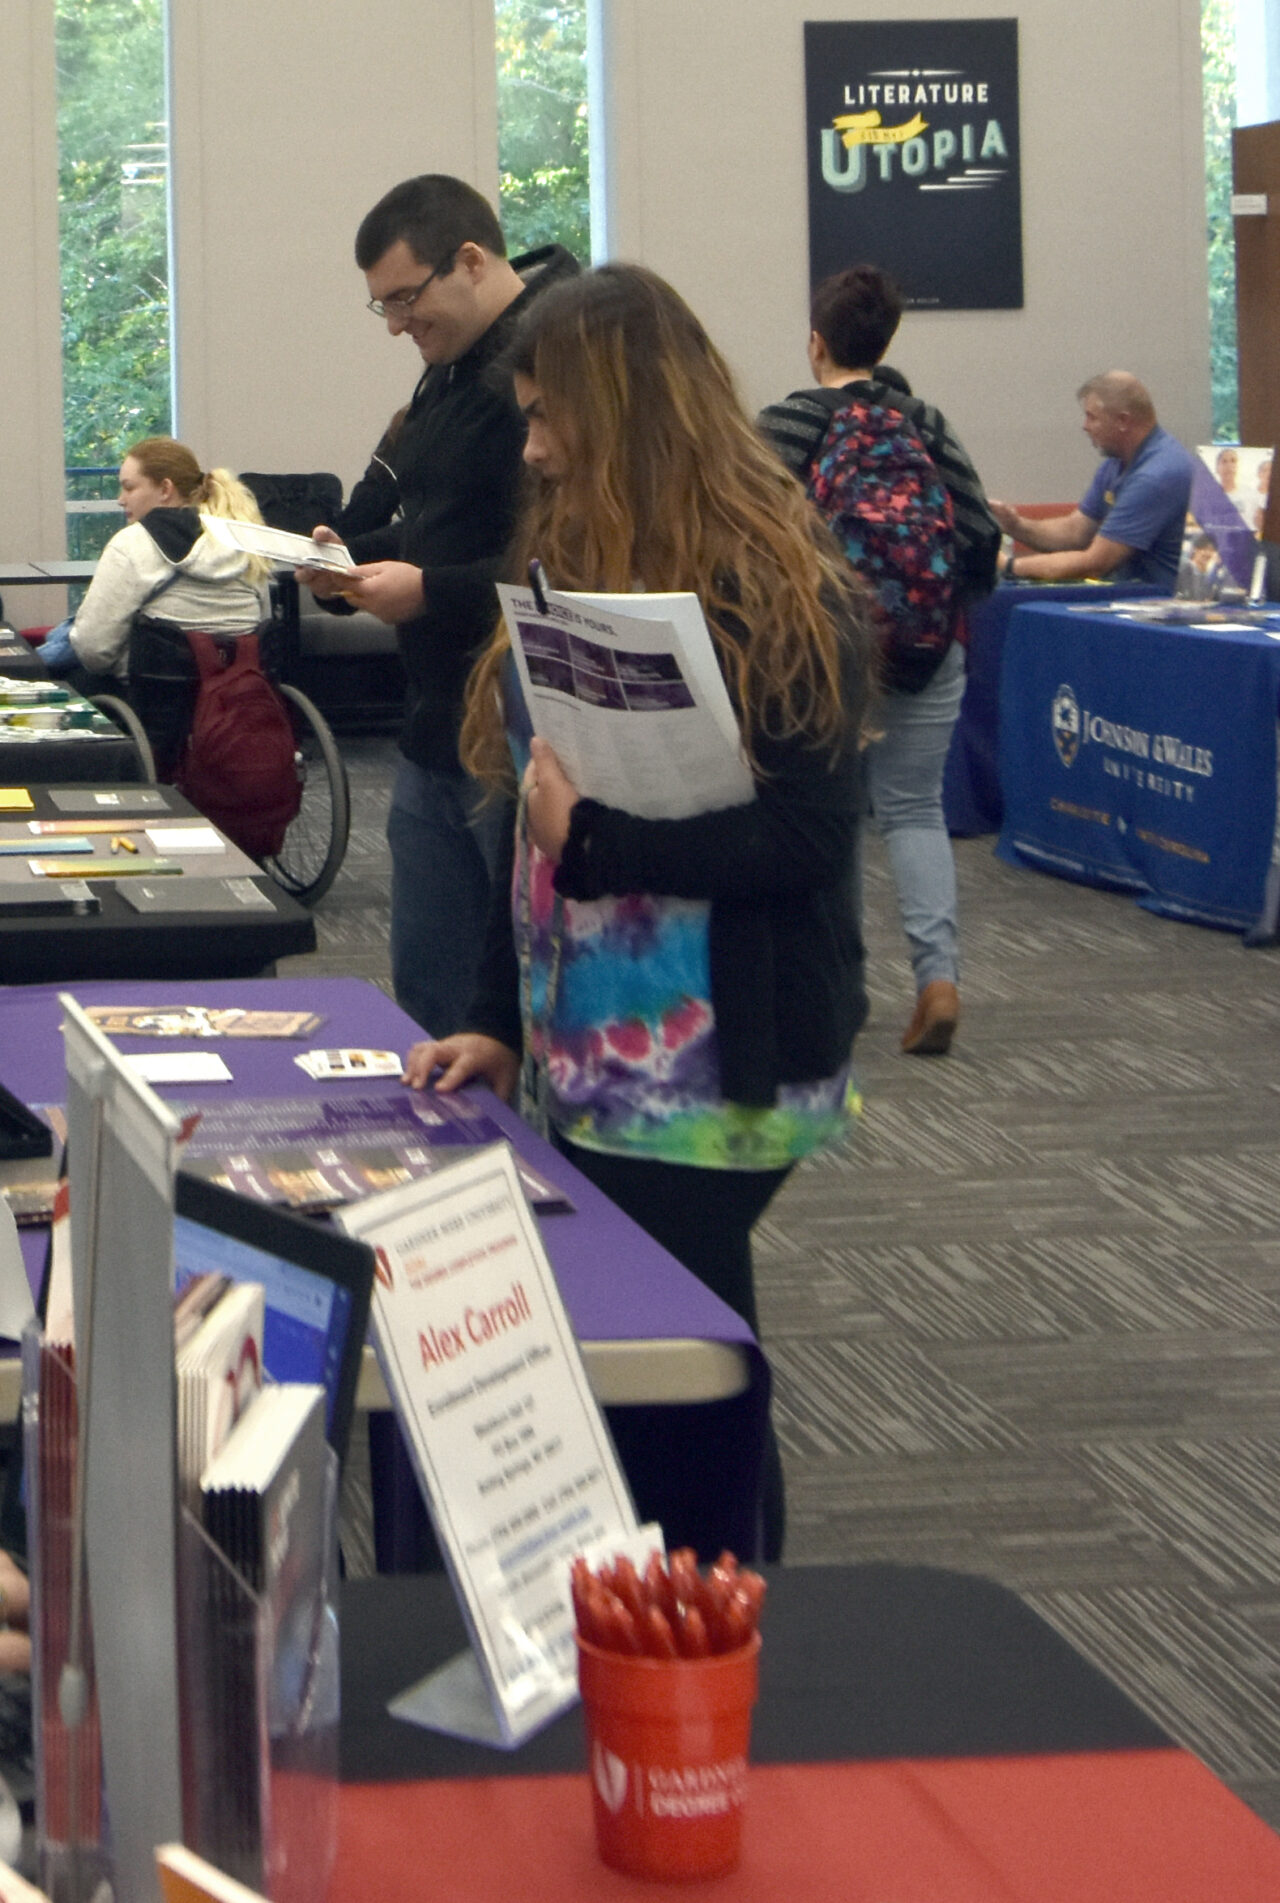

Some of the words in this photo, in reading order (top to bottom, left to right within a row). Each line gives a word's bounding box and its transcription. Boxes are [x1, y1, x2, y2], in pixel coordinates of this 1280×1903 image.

[844, 83, 989, 105] LITERATURE
[821, 119, 1009, 193] UTOPIA
[418, 1322, 467, 1373] Alex
[464, 1280, 532, 1346] Carroll
